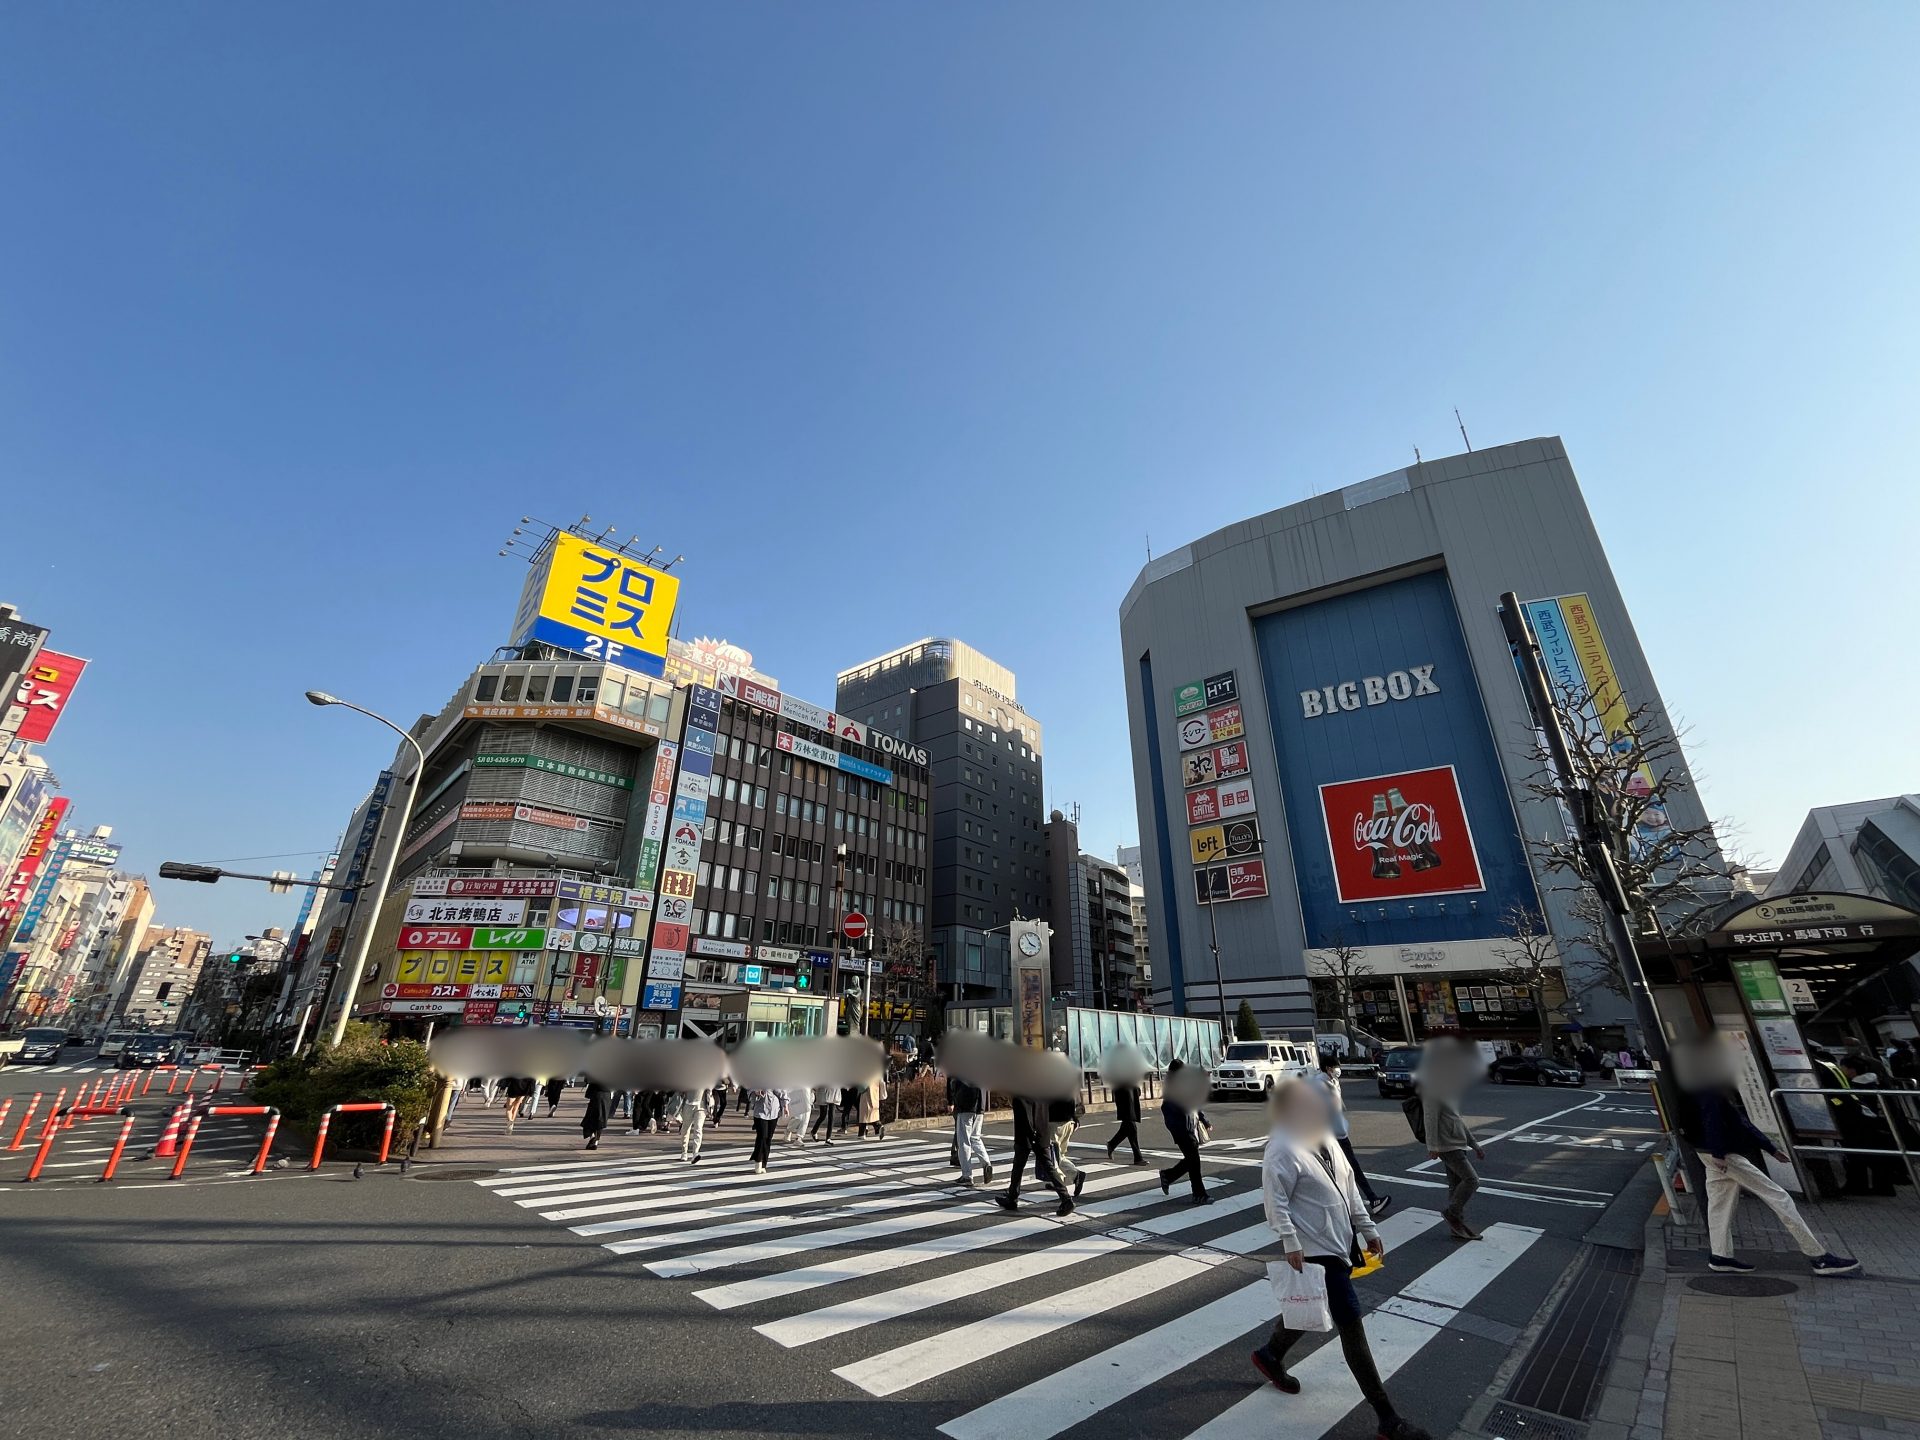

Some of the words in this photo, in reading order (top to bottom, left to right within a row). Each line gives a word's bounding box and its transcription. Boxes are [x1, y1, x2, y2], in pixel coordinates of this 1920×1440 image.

[581, 551, 656, 605] プロ
[570, 586, 645, 639] ミス
[582, 635, 624, 661] 2F
[696, 696, 717, 709] ビル
[745, 685, 780, 710] 日能研
[784, 700, 819, 716] コンタクトレンズ
[783, 705, 808, 720] Menicon
[811, 716, 827, 727] Miru
[1215, 718, 1235, 729] NEXT
[1182, 728, 1206, 738] スシロー
[779, 736, 791, 748] 本
[794, 741, 837, 764] 芳林堂書店
[872, 731, 927, 766] TOMAS
[486, 756, 525, 764] 03-6265-9570
[537, 760, 625, 787] 日本語教師養成講座
[1193, 803, 1215, 816] GAME
[28, 810, 59, 857] パチンコ
[1354, 803, 1442, 851] Coca-Cola
[675, 838, 696, 846] TOMAS
[638, 847, 649, 879] 日本語学校
[1379, 855, 1397, 864] Real
[1398, 852, 1424, 863] Magic
[1230, 867, 1244, 876] 日産
[465, 882, 498, 890] 行知学園
[1231, 874, 1262, 885] レンタカー
[429, 907, 502, 921] 北京烤鴨店
[507, 913, 519, 921] 3F
[1776, 903, 1835, 914] 高田馬場駅前
[426, 932, 461, 944] アコム
[489, 931, 528, 944] レイク
[1733, 927, 1848, 944] 早大正門・馬場下町
[1859, 925, 1874, 936] 行
[702, 945, 725, 953] Menicon
[727, 947, 741, 955] Miru
[1400, 947, 1445, 962] Emio
[405, 957, 503, 974] プロミス
[431, 985, 461, 996] ガスト
[653, 989, 672, 998] 英会話
[650, 997, 674, 1005] イーオン
